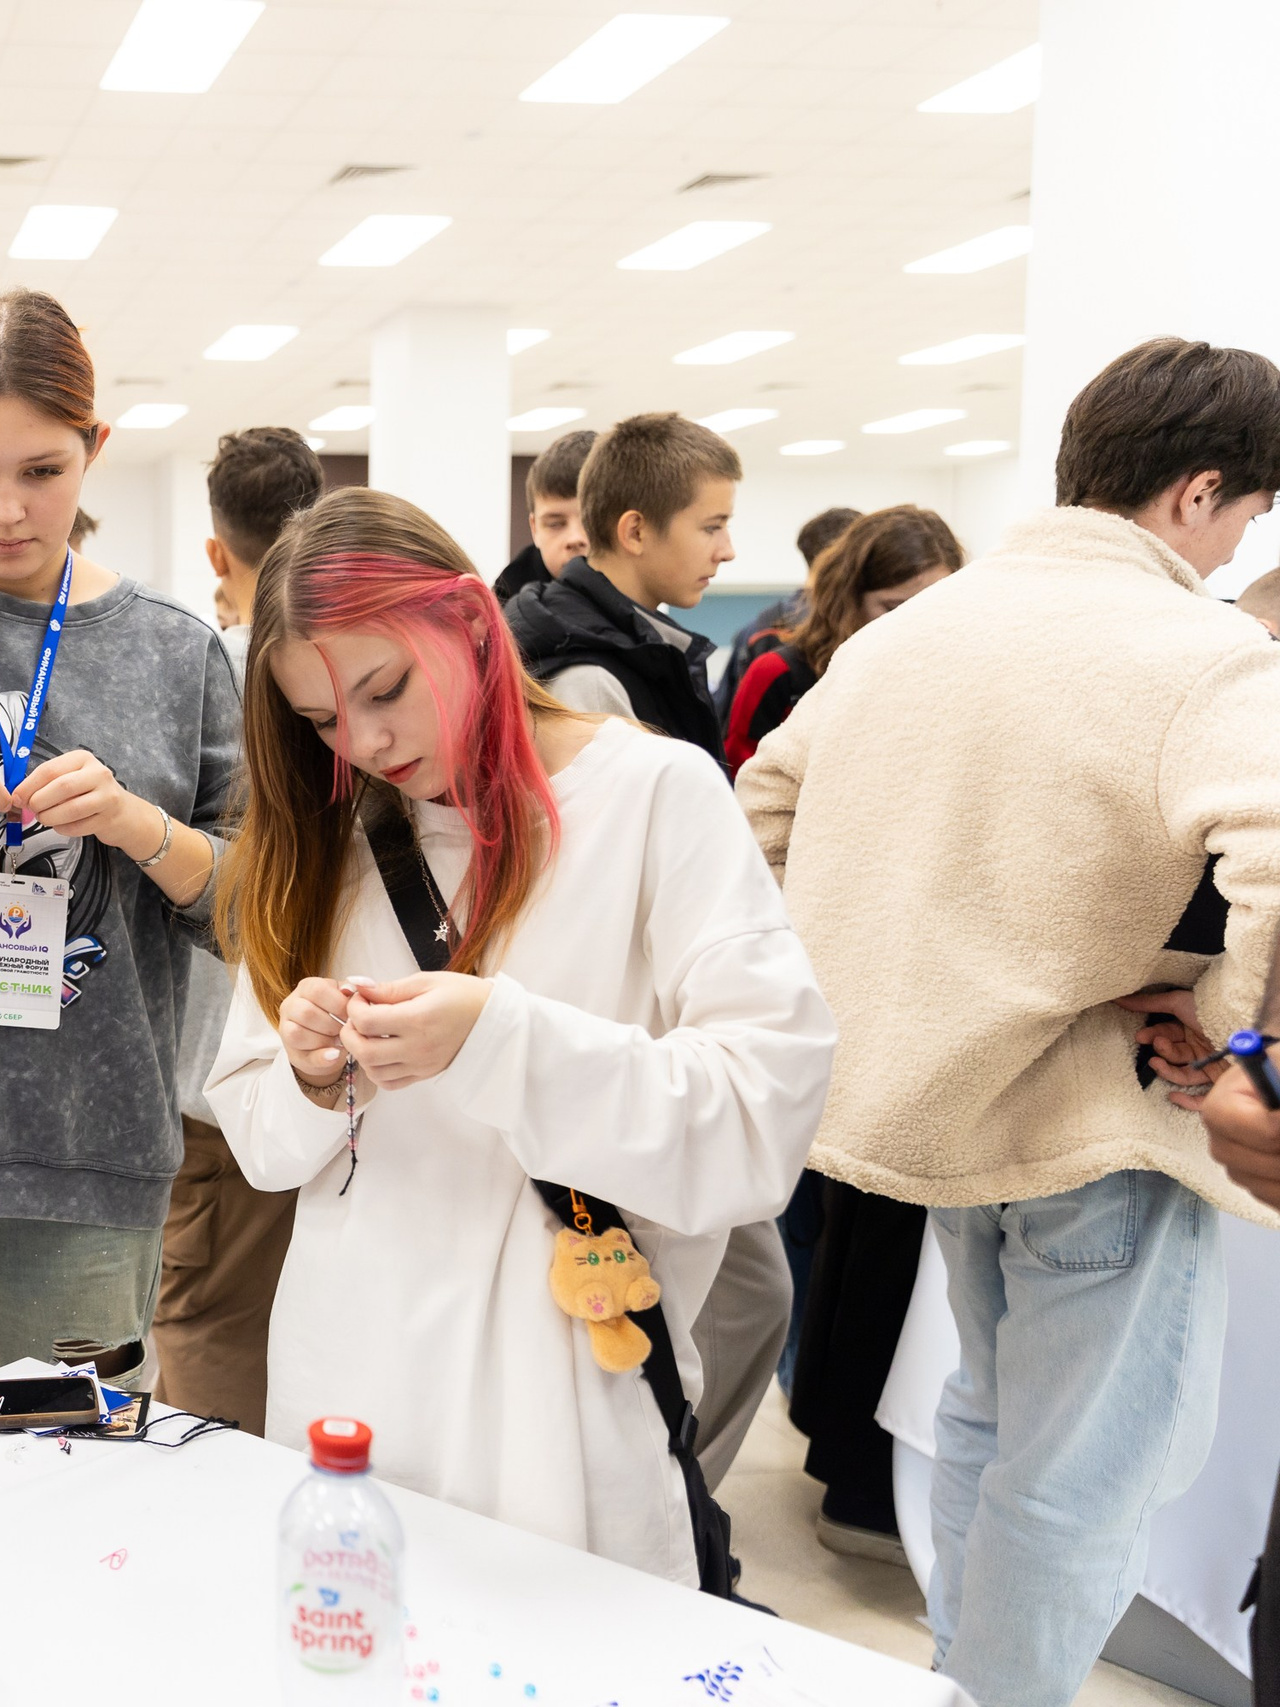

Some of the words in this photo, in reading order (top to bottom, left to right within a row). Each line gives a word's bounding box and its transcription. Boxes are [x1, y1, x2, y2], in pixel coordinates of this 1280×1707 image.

[28, 647, 52, 717] ФИНАНСОВЫЙ
[25, 718, 36, 730] IQ
[39, 945, 49, 953] IQ
[298, 1605, 363, 1629] saint
[291, 1623, 373, 1658] spring
